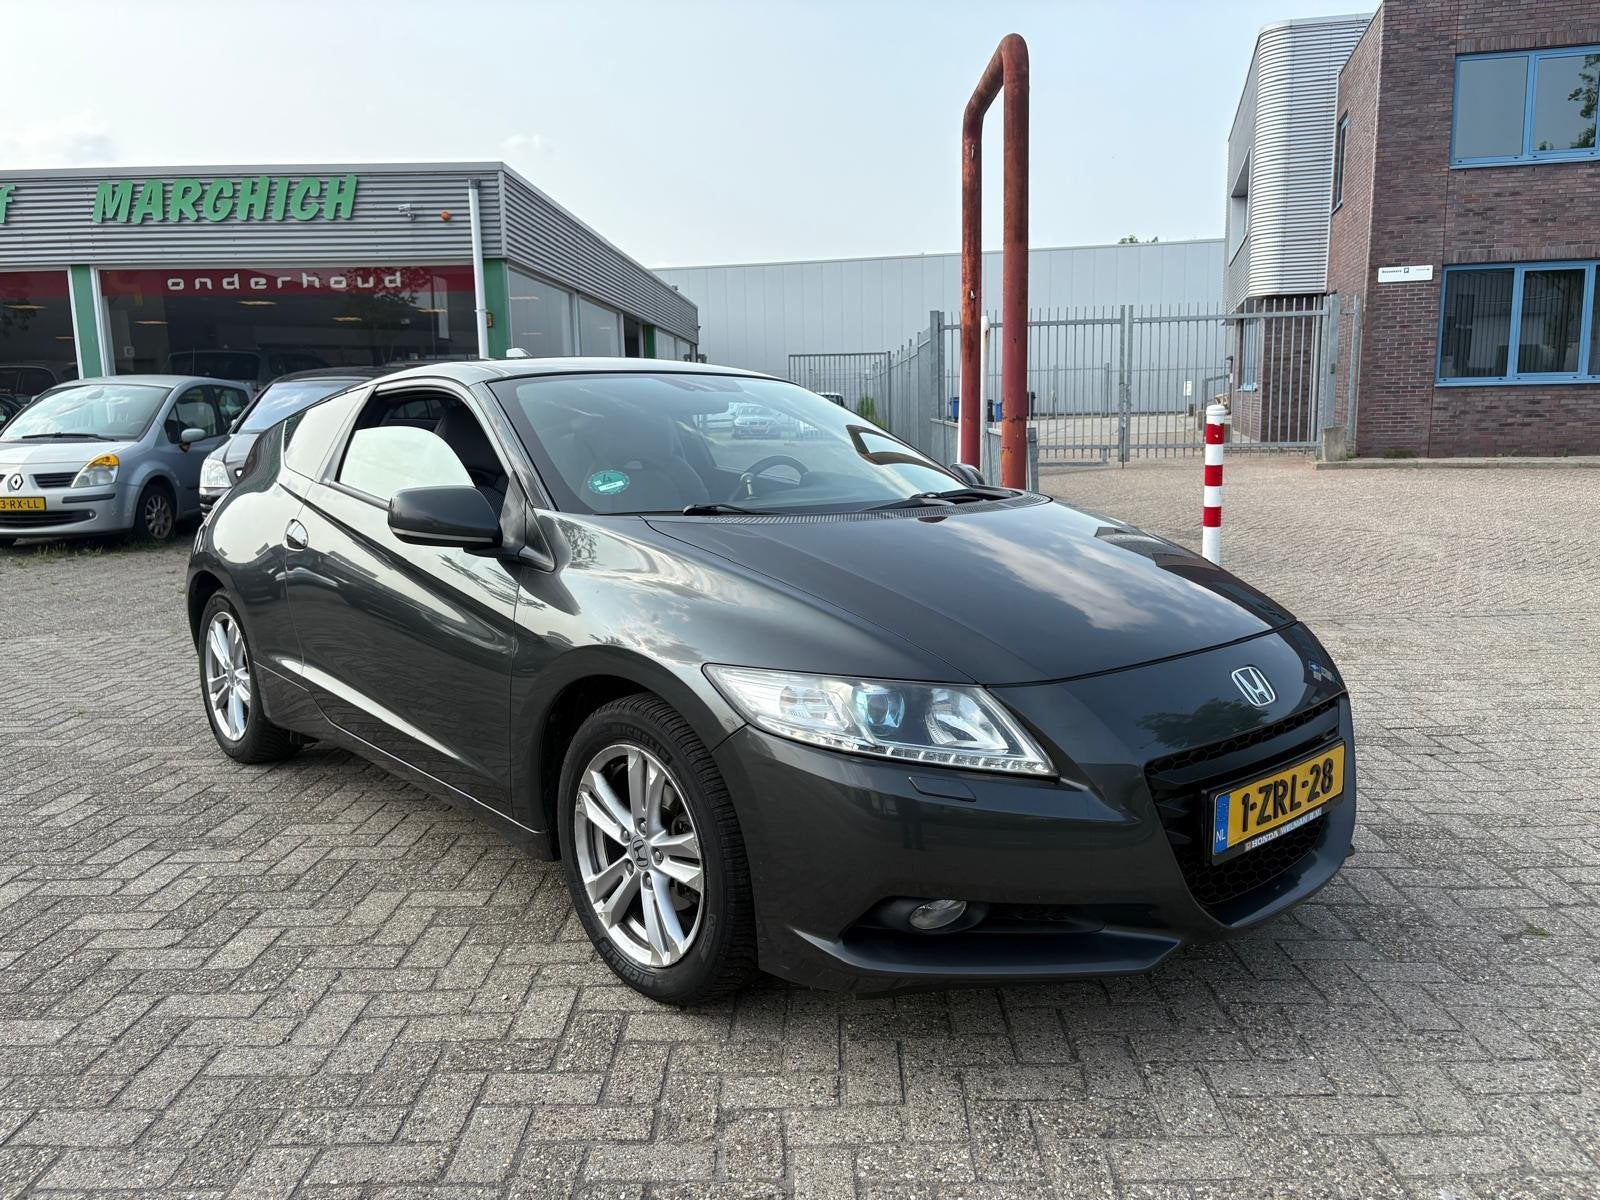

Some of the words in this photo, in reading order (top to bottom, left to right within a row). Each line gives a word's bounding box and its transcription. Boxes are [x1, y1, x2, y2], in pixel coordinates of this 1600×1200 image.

[92, 175, 358, 225] MARGHICH
[167, 271, 402, 291] onderhoud
[1241, 757, 1334, 833] 1-ZRL-28
[1215, 828, 1227, 844] NL
[1251, 830, 1279, 849] HONDA
